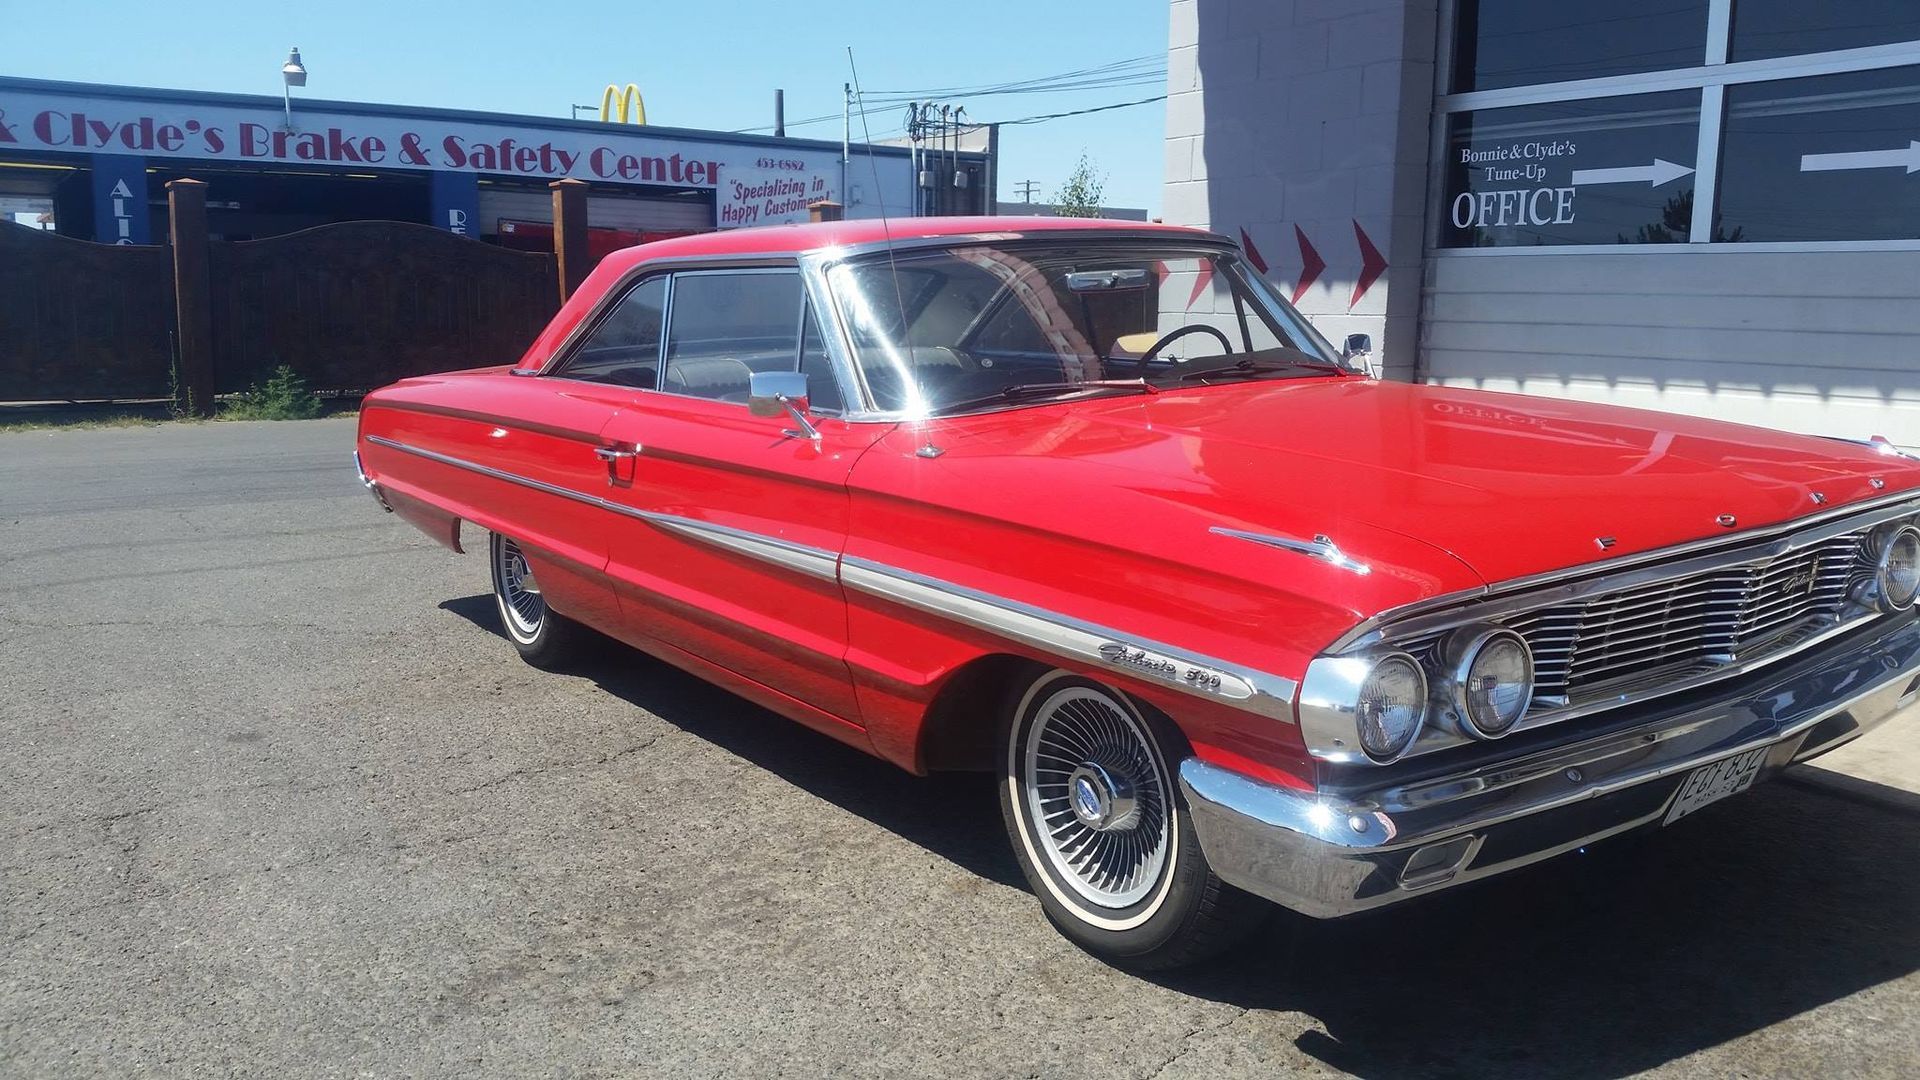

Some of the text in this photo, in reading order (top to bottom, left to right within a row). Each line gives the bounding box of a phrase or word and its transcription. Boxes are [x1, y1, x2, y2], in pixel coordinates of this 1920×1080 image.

[33, 110, 225, 154] Clyde's
[239, 122, 386, 163] Brake
[398, 132, 431, 167] &
[443, 135, 580, 175] Safety
[590, 147, 725, 185] Center
[1461, 140, 1576, 163] Bonnie & Clyde's
[812, 175, 824, 192] in
[1485, 164, 1547, 183] Tune-Up
[110, 178, 134, 245] ALI
[722, 203, 759, 223] Happy
[1452, 187, 1576, 229] OFFICE
[1184, 668, 1222, 688] 500
